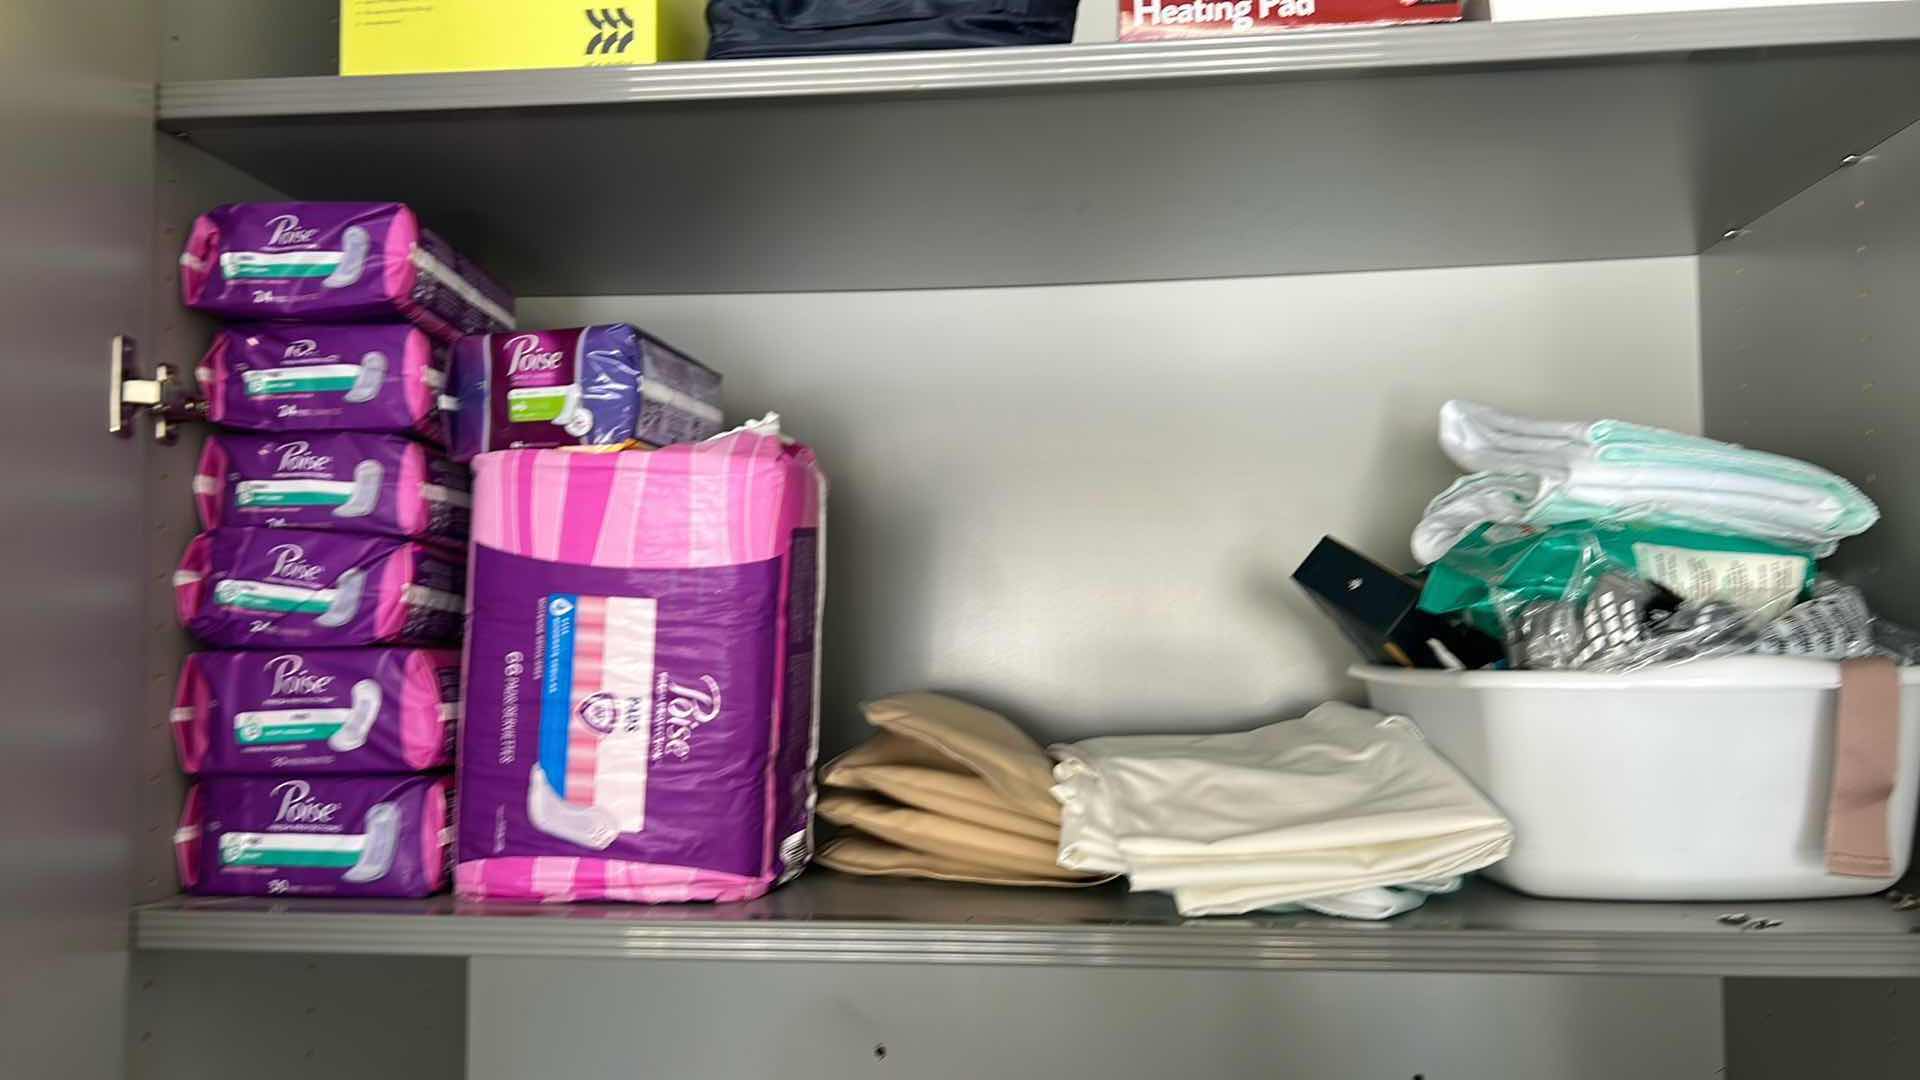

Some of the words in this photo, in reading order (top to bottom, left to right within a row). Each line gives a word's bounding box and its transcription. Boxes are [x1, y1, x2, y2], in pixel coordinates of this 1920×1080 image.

[1133, 0, 1253, 30] Heating
[264, 214, 319, 246] Poise
[503, 334, 564, 376] Poise
[274, 440, 334, 472] Poise
[265, 543, 324, 580] Poise
[264, 654, 336, 697] Poise
[665, 674, 721, 760] Poise
[270, 780, 342, 822] Poise
